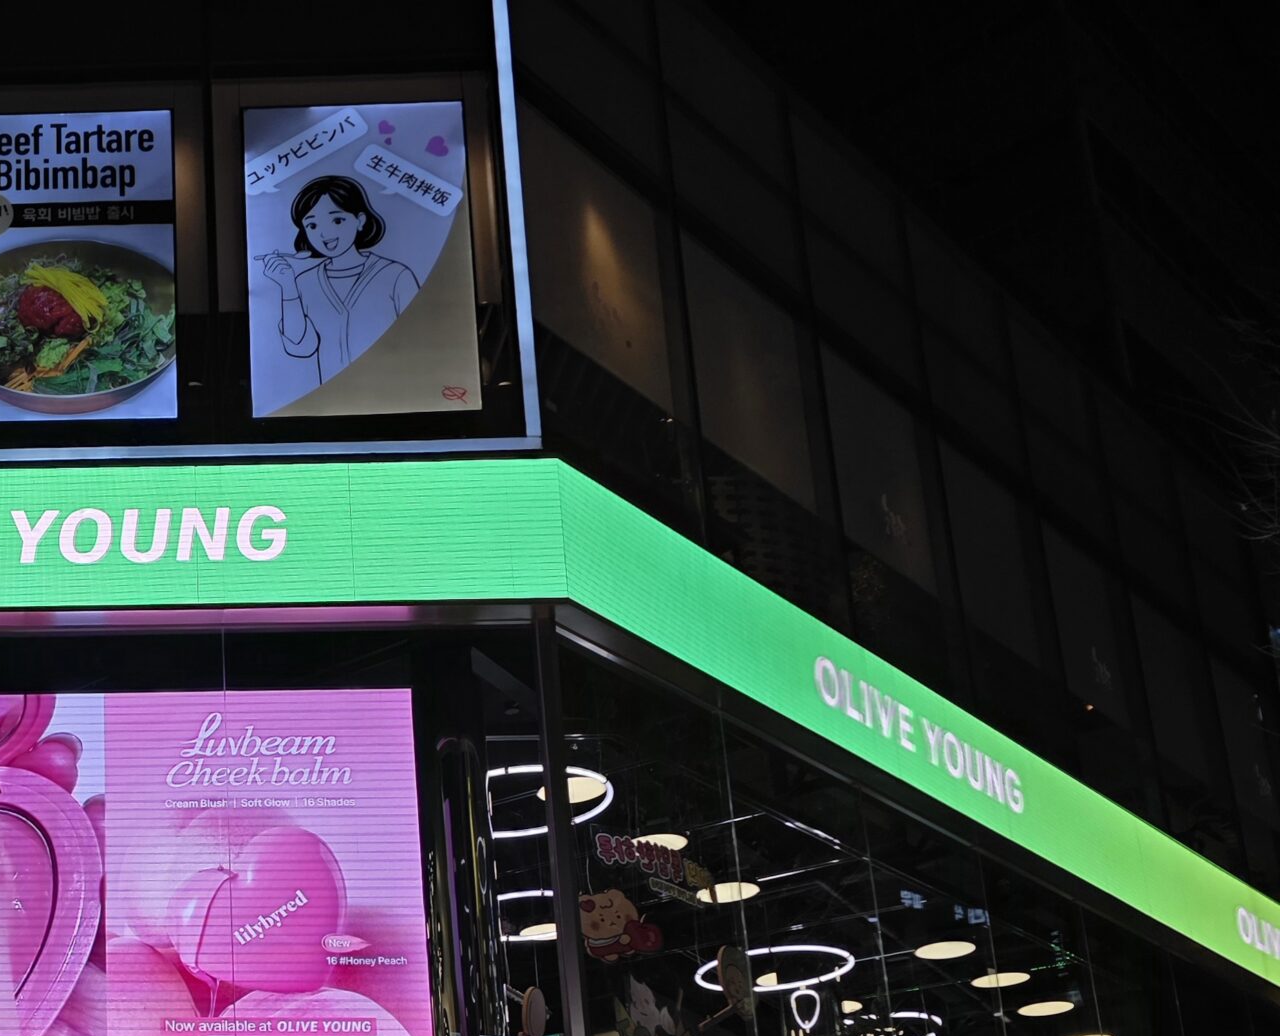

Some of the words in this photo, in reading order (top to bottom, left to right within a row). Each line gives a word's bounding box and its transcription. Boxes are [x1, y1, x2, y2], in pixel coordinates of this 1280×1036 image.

[50, 123, 154, 154] Tartare
[247, 115, 357, 186] ユッケビビンバ
[366, 153, 452, 208] 生牛肉拌饭
[22, 207, 53, 222] 육회
[58, 206, 100, 221] 비빔밥
[106, 205, 135, 220] 출시
[10, 505, 287, 565] YOUNG
[180, 712, 336, 758] Luvbeam
[814, 656, 917, 752] OLIVE
[922, 717, 1025, 813] YOUNG
[166, 758, 268, 788] Cheek
[270, 756, 352, 786] balm
[165, 799, 198, 808] Cream
[200, 799, 228, 808] Blush
[241, 799, 262, 808] Soft
[264, 799, 290, 808] Glow
[302, 798, 315, 807] 16
[318, 798, 356, 807] Shades
[233, 889, 308, 946] lilybyred
[328, 938, 351, 948] New
[326, 957, 337, 966] 16
[339, 957, 376, 967] #Honey
[378, 957, 408, 966] Peach
[165, 1021, 195, 1032] Now
[199, 1020, 256, 1032] available
[259, 1022, 272, 1032] at
[277, 1021, 318, 1032] OLIVE
[322, 1021, 372, 1032] YOUNG
